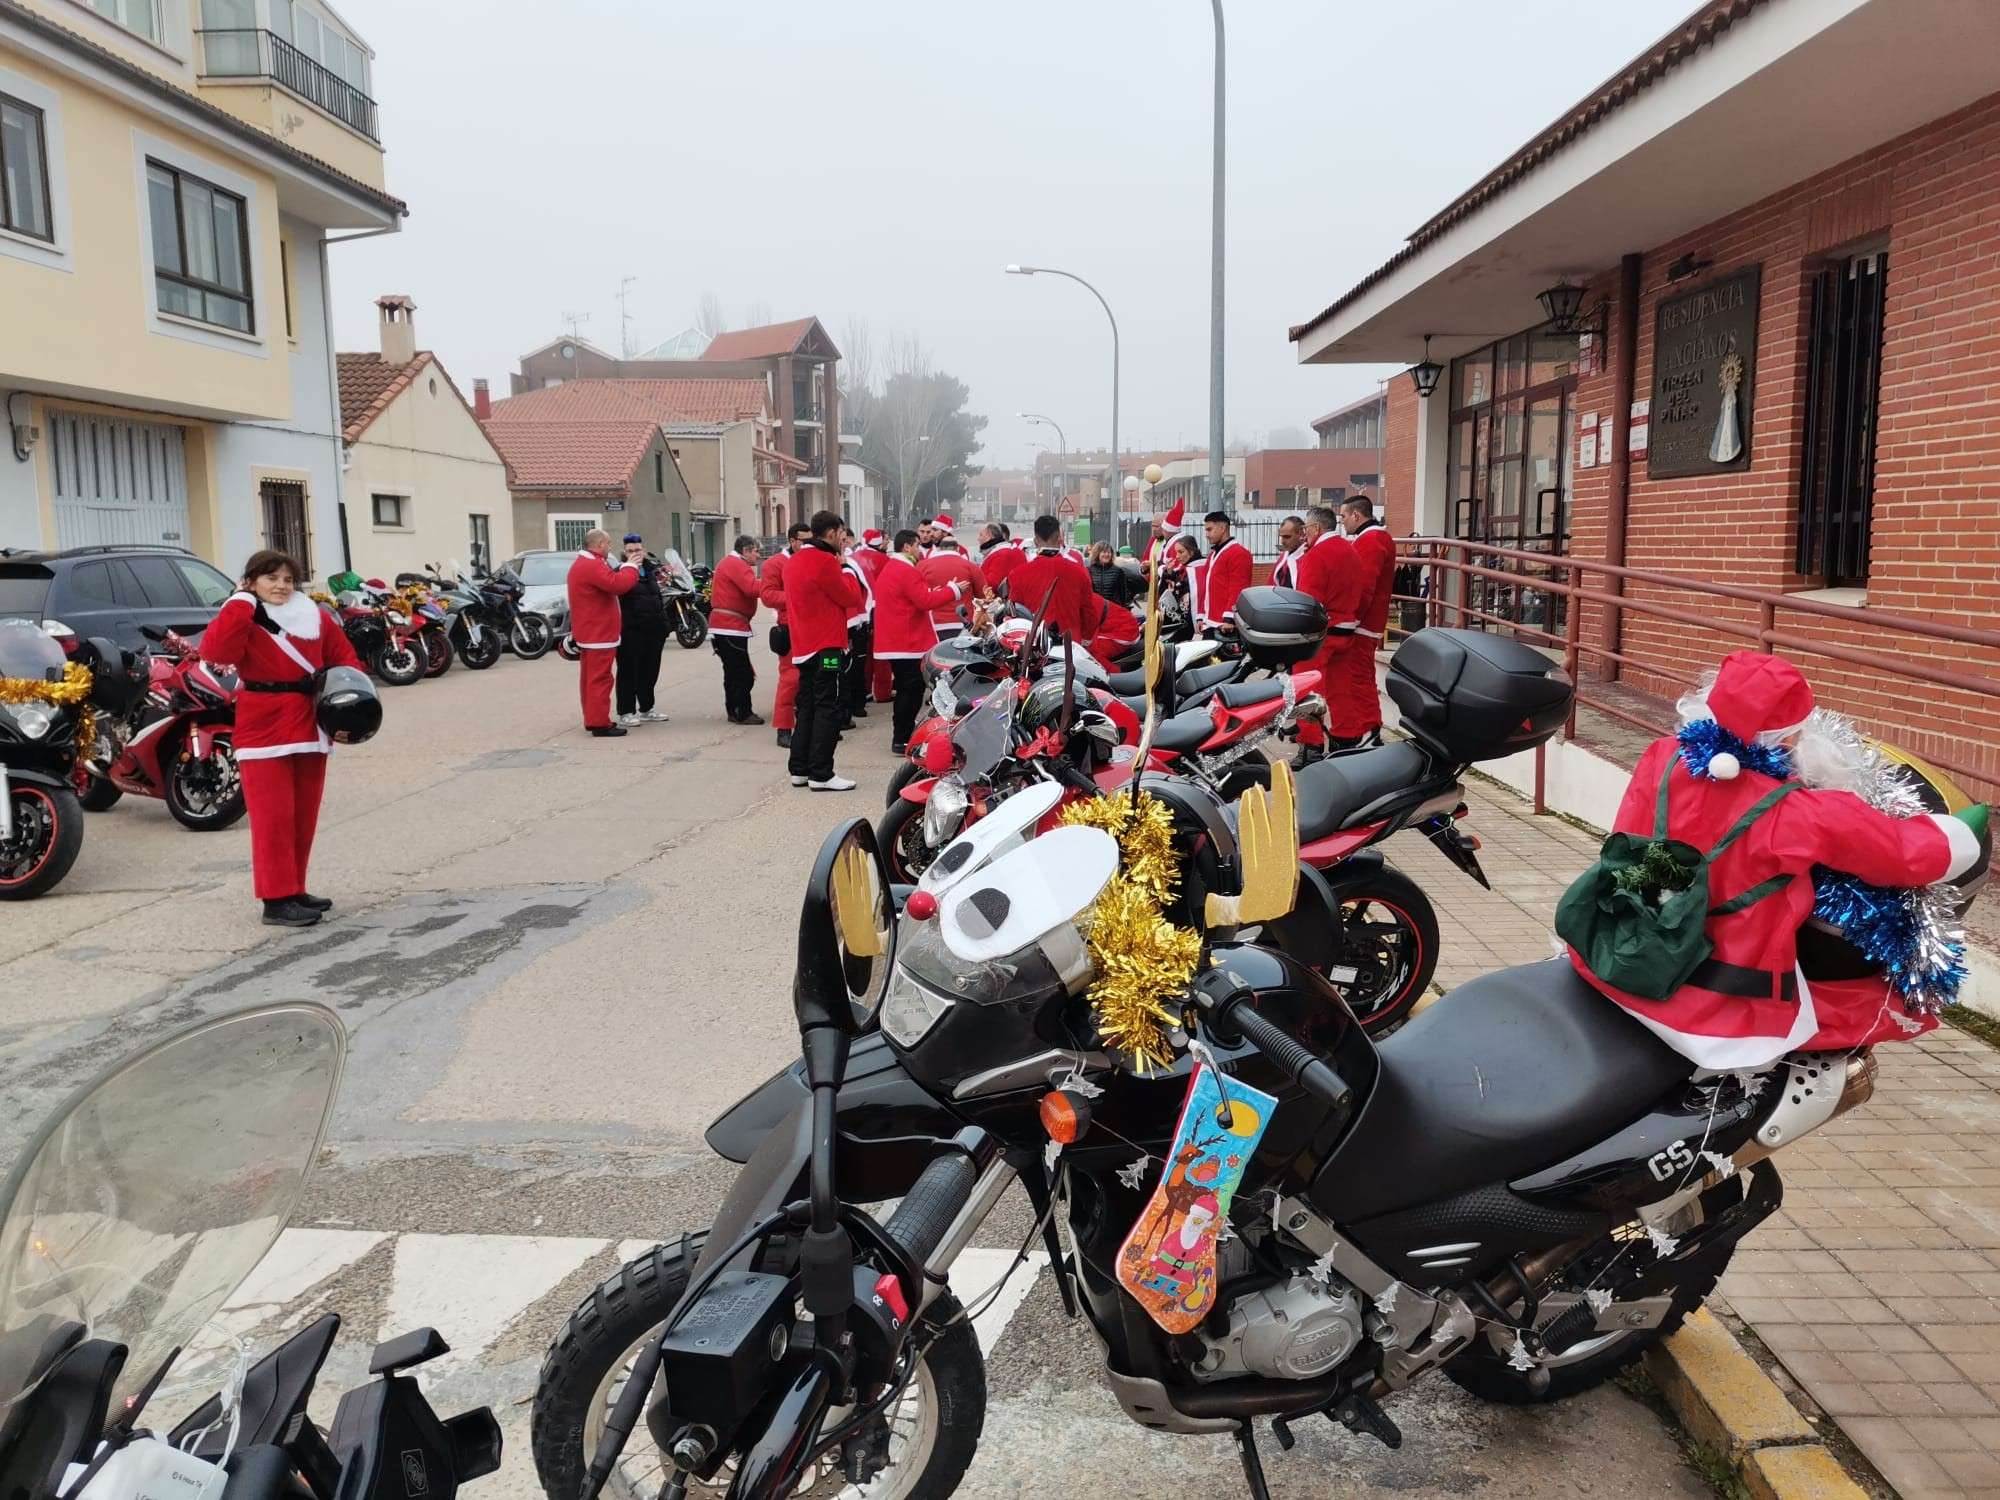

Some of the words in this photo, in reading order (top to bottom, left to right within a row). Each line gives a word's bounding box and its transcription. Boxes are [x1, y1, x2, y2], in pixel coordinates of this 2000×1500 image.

[1663, 283, 1744, 330] RESIDENCIA
[1664, 328, 1737, 370] ANCIANOS
[1648, 1140, 1694, 1181] GS
